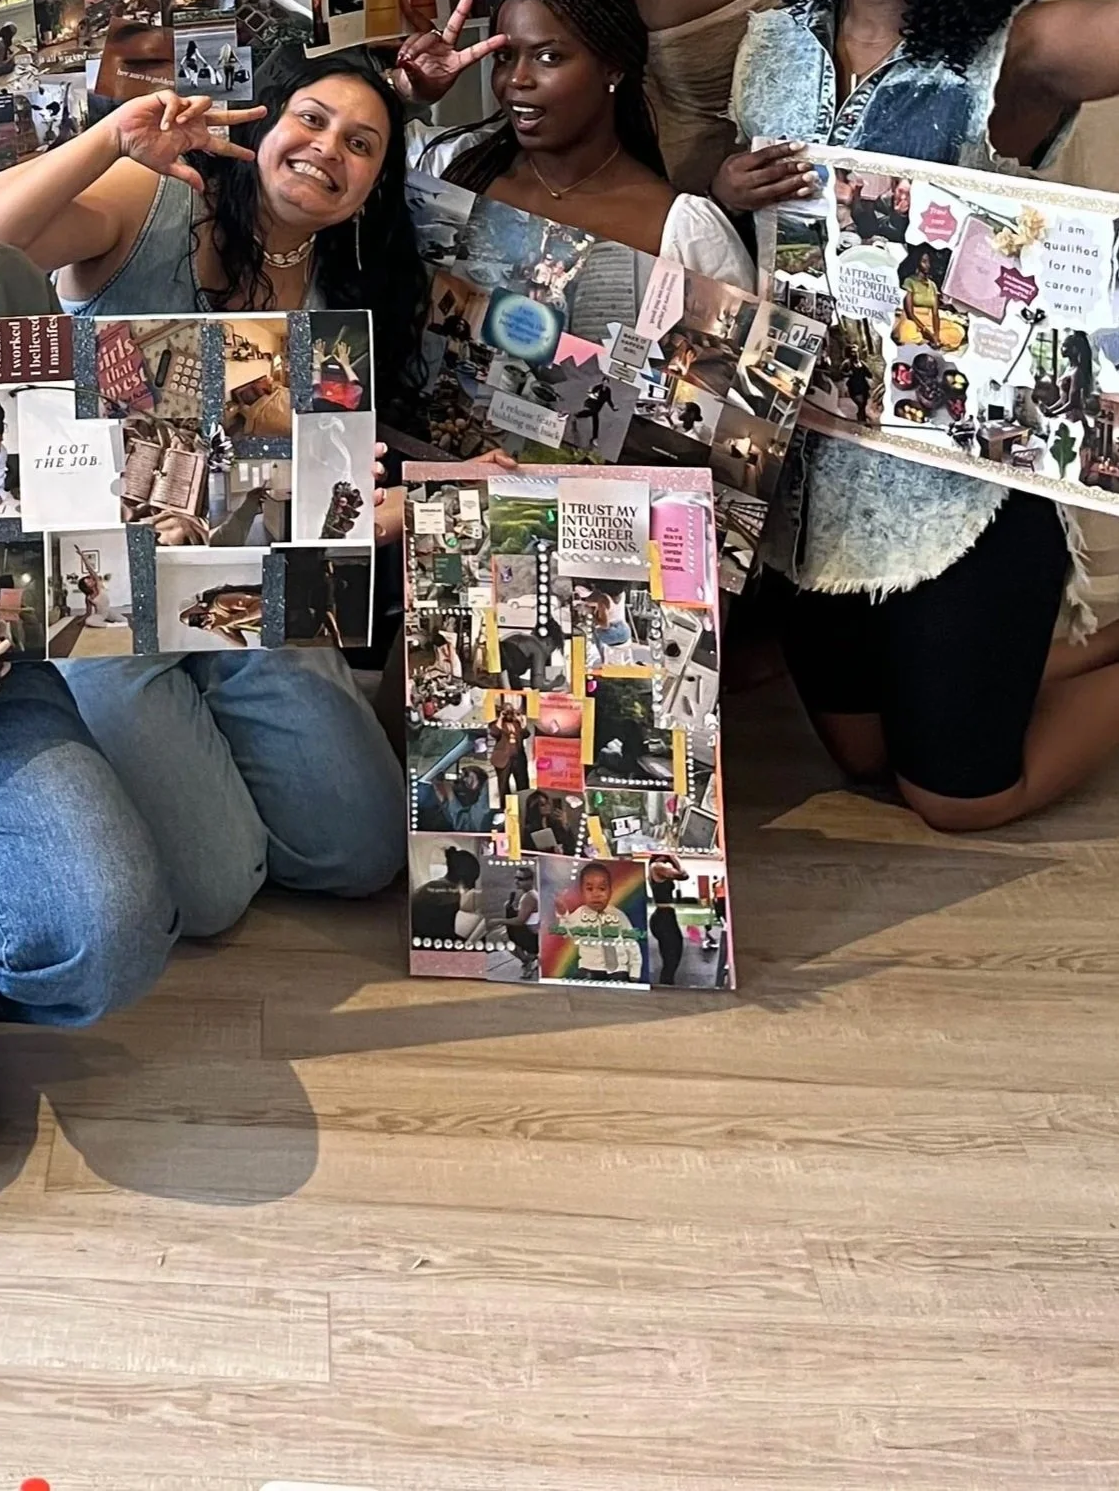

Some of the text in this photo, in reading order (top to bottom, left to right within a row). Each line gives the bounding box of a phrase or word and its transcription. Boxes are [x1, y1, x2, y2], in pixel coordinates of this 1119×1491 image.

[1068, 226, 1085, 236] am
[1043, 241, 1099, 258] qualified
[1048, 259, 1092, 276] for the
[844, 267, 887, 284] ATTRACT
[839, 276, 899, 296] SUPPORTIVE
[1044, 280, 1085, 295] career
[838, 285, 901, 305] COLLEAGUES
[839, 293, 859, 304] AND
[1053, 302, 1083, 315] want
[8, 321, 21, 369] worked
[28, 316, 41, 367] believed
[106, 360, 133, 383] that
[47, 443, 91, 456] I GOT
[33, 457, 65, 469] THE
[562, 502, 638, 518] I TRUST MY
[562, 515, 633, 529] INTUITION
[562, 526, 634, 541] IN CAREER
[562, 538, 640, 553] DECISIONS.
